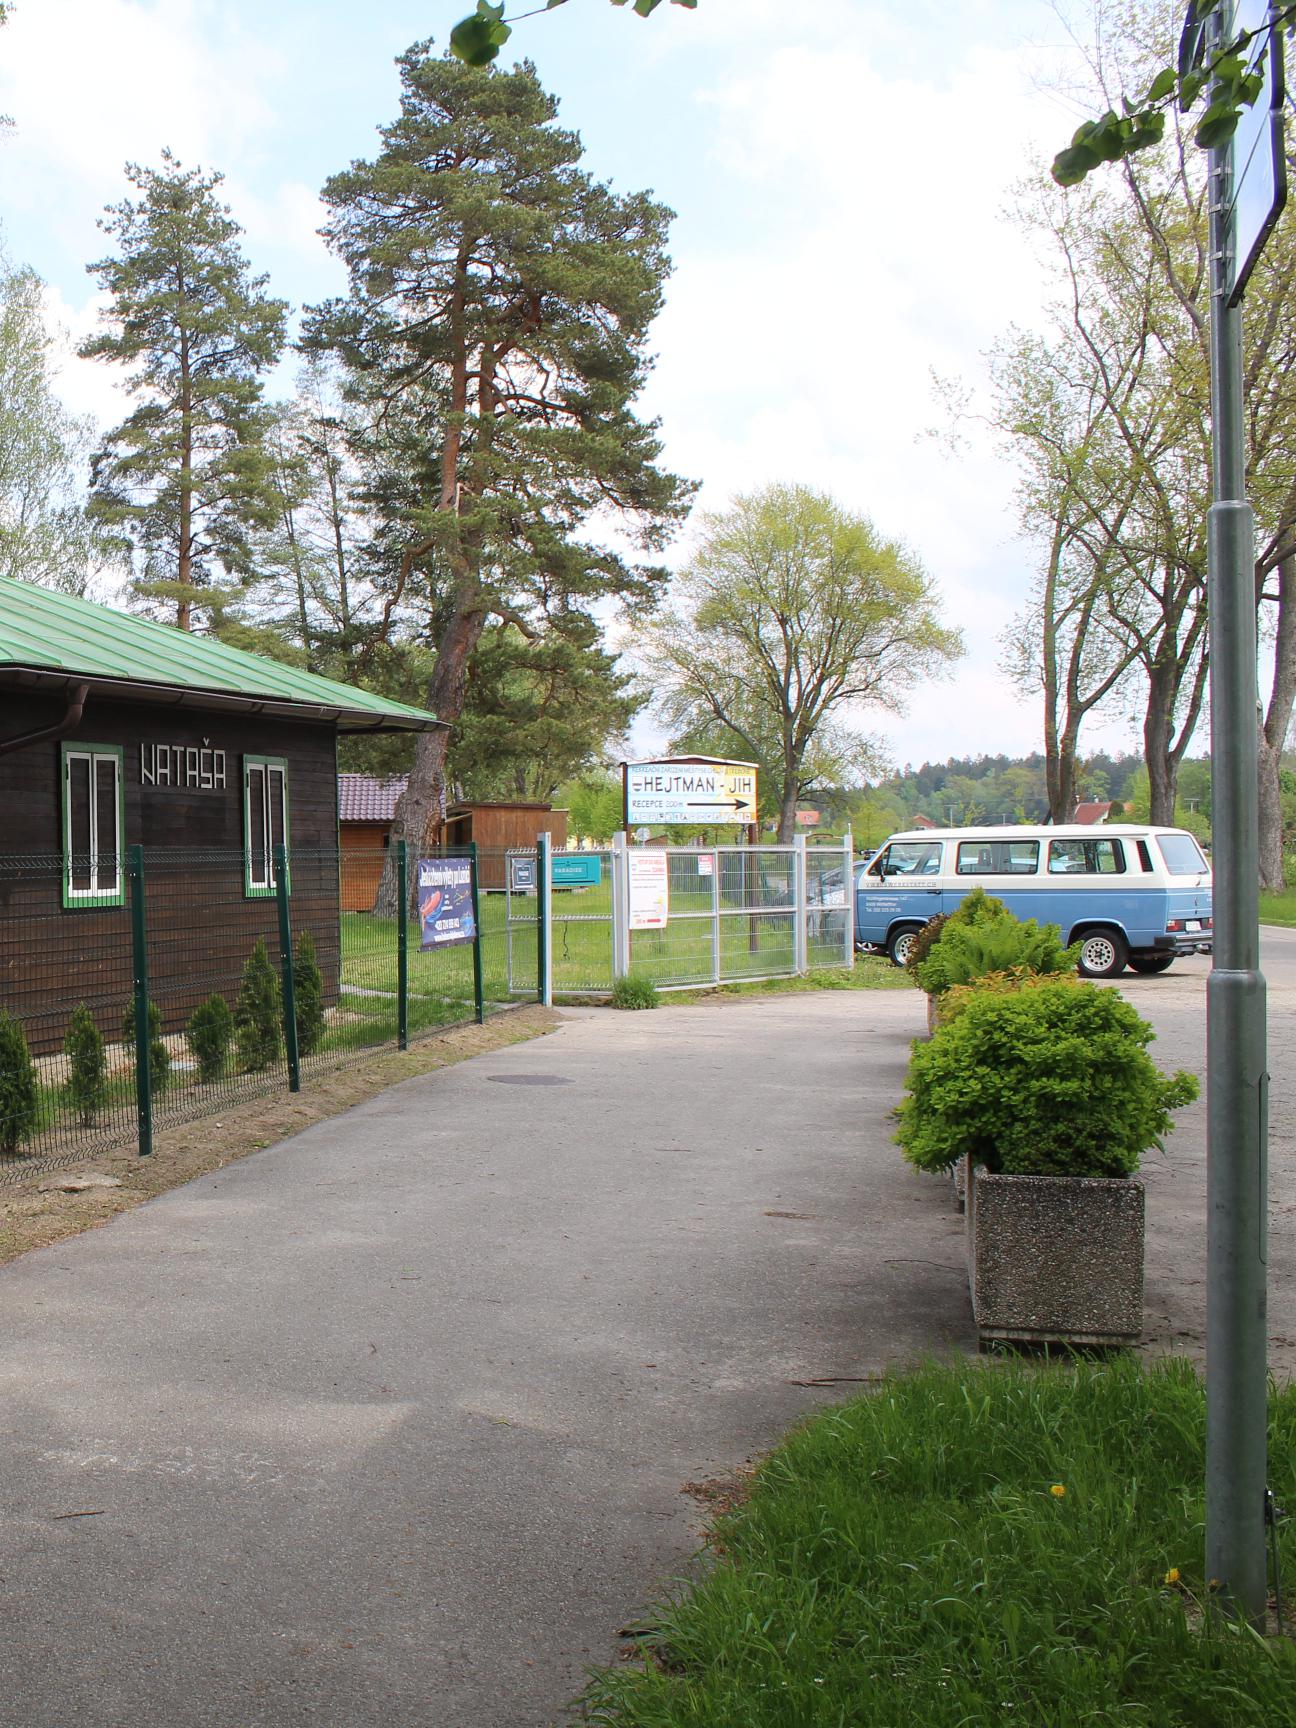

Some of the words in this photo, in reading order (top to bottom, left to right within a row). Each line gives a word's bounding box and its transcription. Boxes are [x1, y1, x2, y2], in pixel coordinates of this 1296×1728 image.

[141, 737, 226, 789] NATAŠA
[644, 777, 715, 793] HEJTMAN
[729, 778, 751, 793] JIH
[632, 800, 663, 808] RECEPCE
